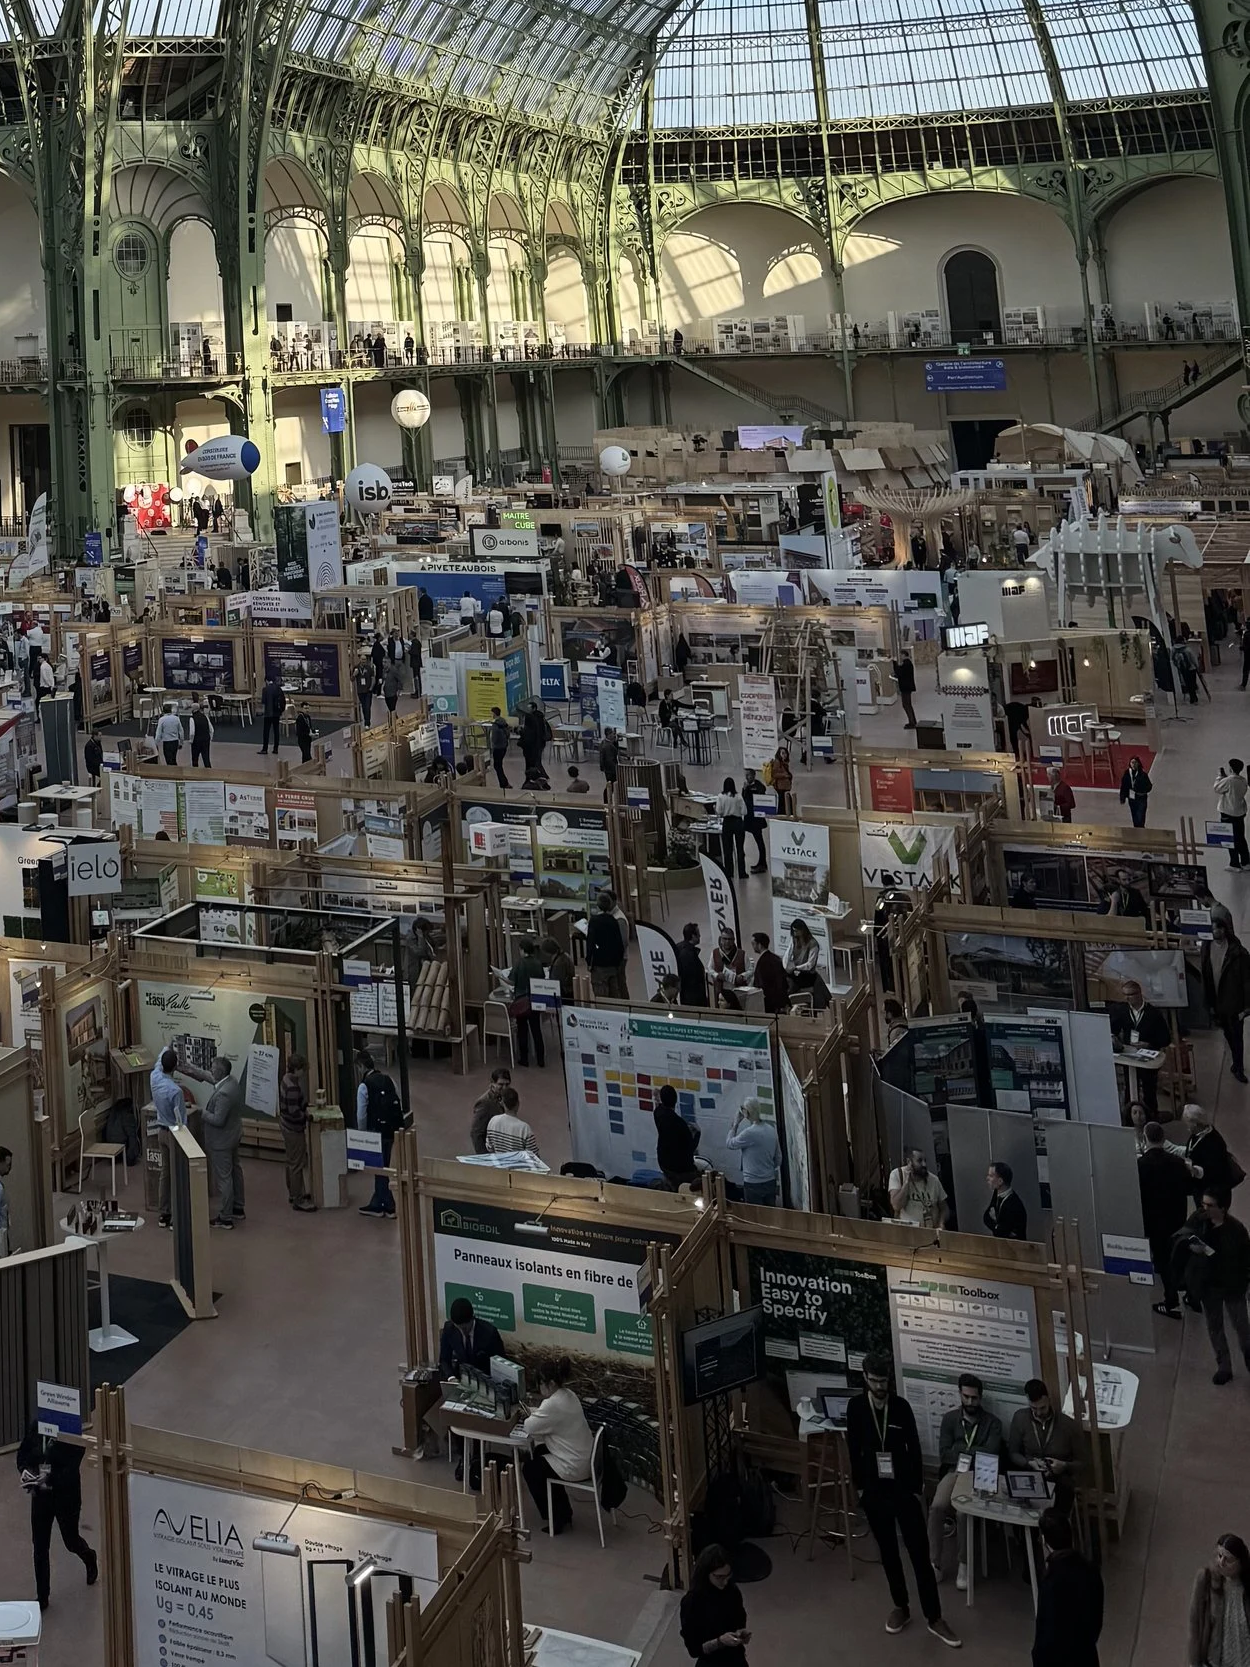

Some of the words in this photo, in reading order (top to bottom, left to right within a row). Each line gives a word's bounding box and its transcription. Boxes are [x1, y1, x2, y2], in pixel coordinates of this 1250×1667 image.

[515, 521, 535, 529] CUBE
[781, 846, 819, 859] VESTACK
[463, 1221, 501, 1235] BIOEDIL
[454, 1250, 512, 1270] Panneaux
[515, 1258, 563, 1279] isolants
[566, 1268, 581, 1281] en
[584, 1270, 614, 1287] fibre
[617, 1275, 634, 1289] de
[759, 1266, 853, 1296] Innovation
[761, 1282, 802, 1305] Easy
[803, 1291, 823, 1307] to
[958, 1282, 1000, 1302] Toolbox
[762, 1298, 828, 1327] Specify
[40, 1389, 55, 1398] Green
[55, 1391, 76, 1402] Window
[153, 1508, 245, 1551] AVELIA
[154, 1562, 165, 1574] LE
[166, 1565, 205, 1583] VITRAGE
[207, 1574, 217, 1586] LE
[219, 1576, 240, 1591] PLUS
[155, 1579, 193, 1599] ISOLANT
[194, 1588, 209, 1601] AU
[210, 1592, 248, 1610] MONDE
[156, 1595, 174, 1614] Ug
[187, 1602, 214, 1621] 0,45
